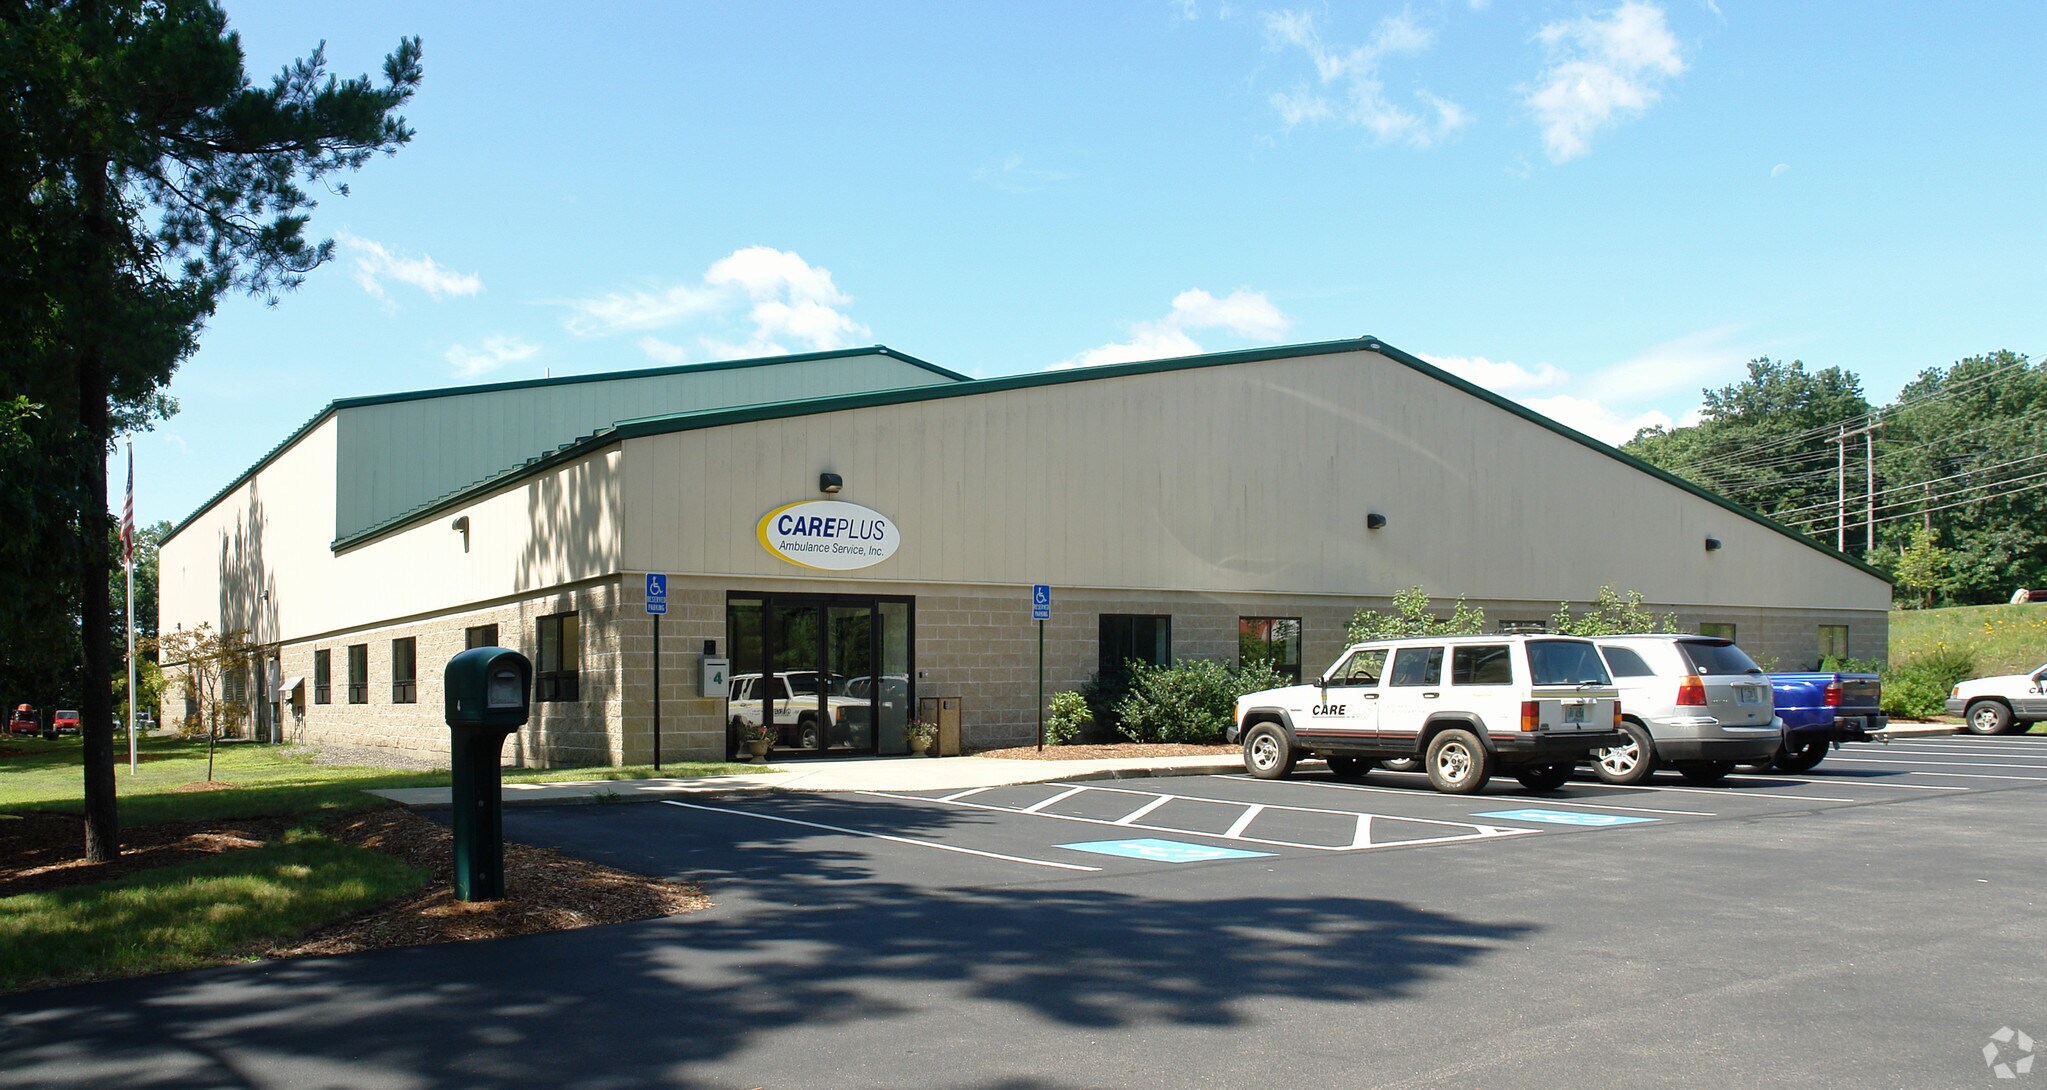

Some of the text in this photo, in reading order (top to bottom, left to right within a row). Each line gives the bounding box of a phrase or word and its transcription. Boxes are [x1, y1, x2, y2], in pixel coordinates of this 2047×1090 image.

[778, 514, 885, 540] CAREPLUS
[779, 540, 884, 557] Ambulance Service, Inc.
[648, 603, 665, 612] PARKING
[713, 671, 723, 685] 4
[1312, 704, 1346, 716] CARE
